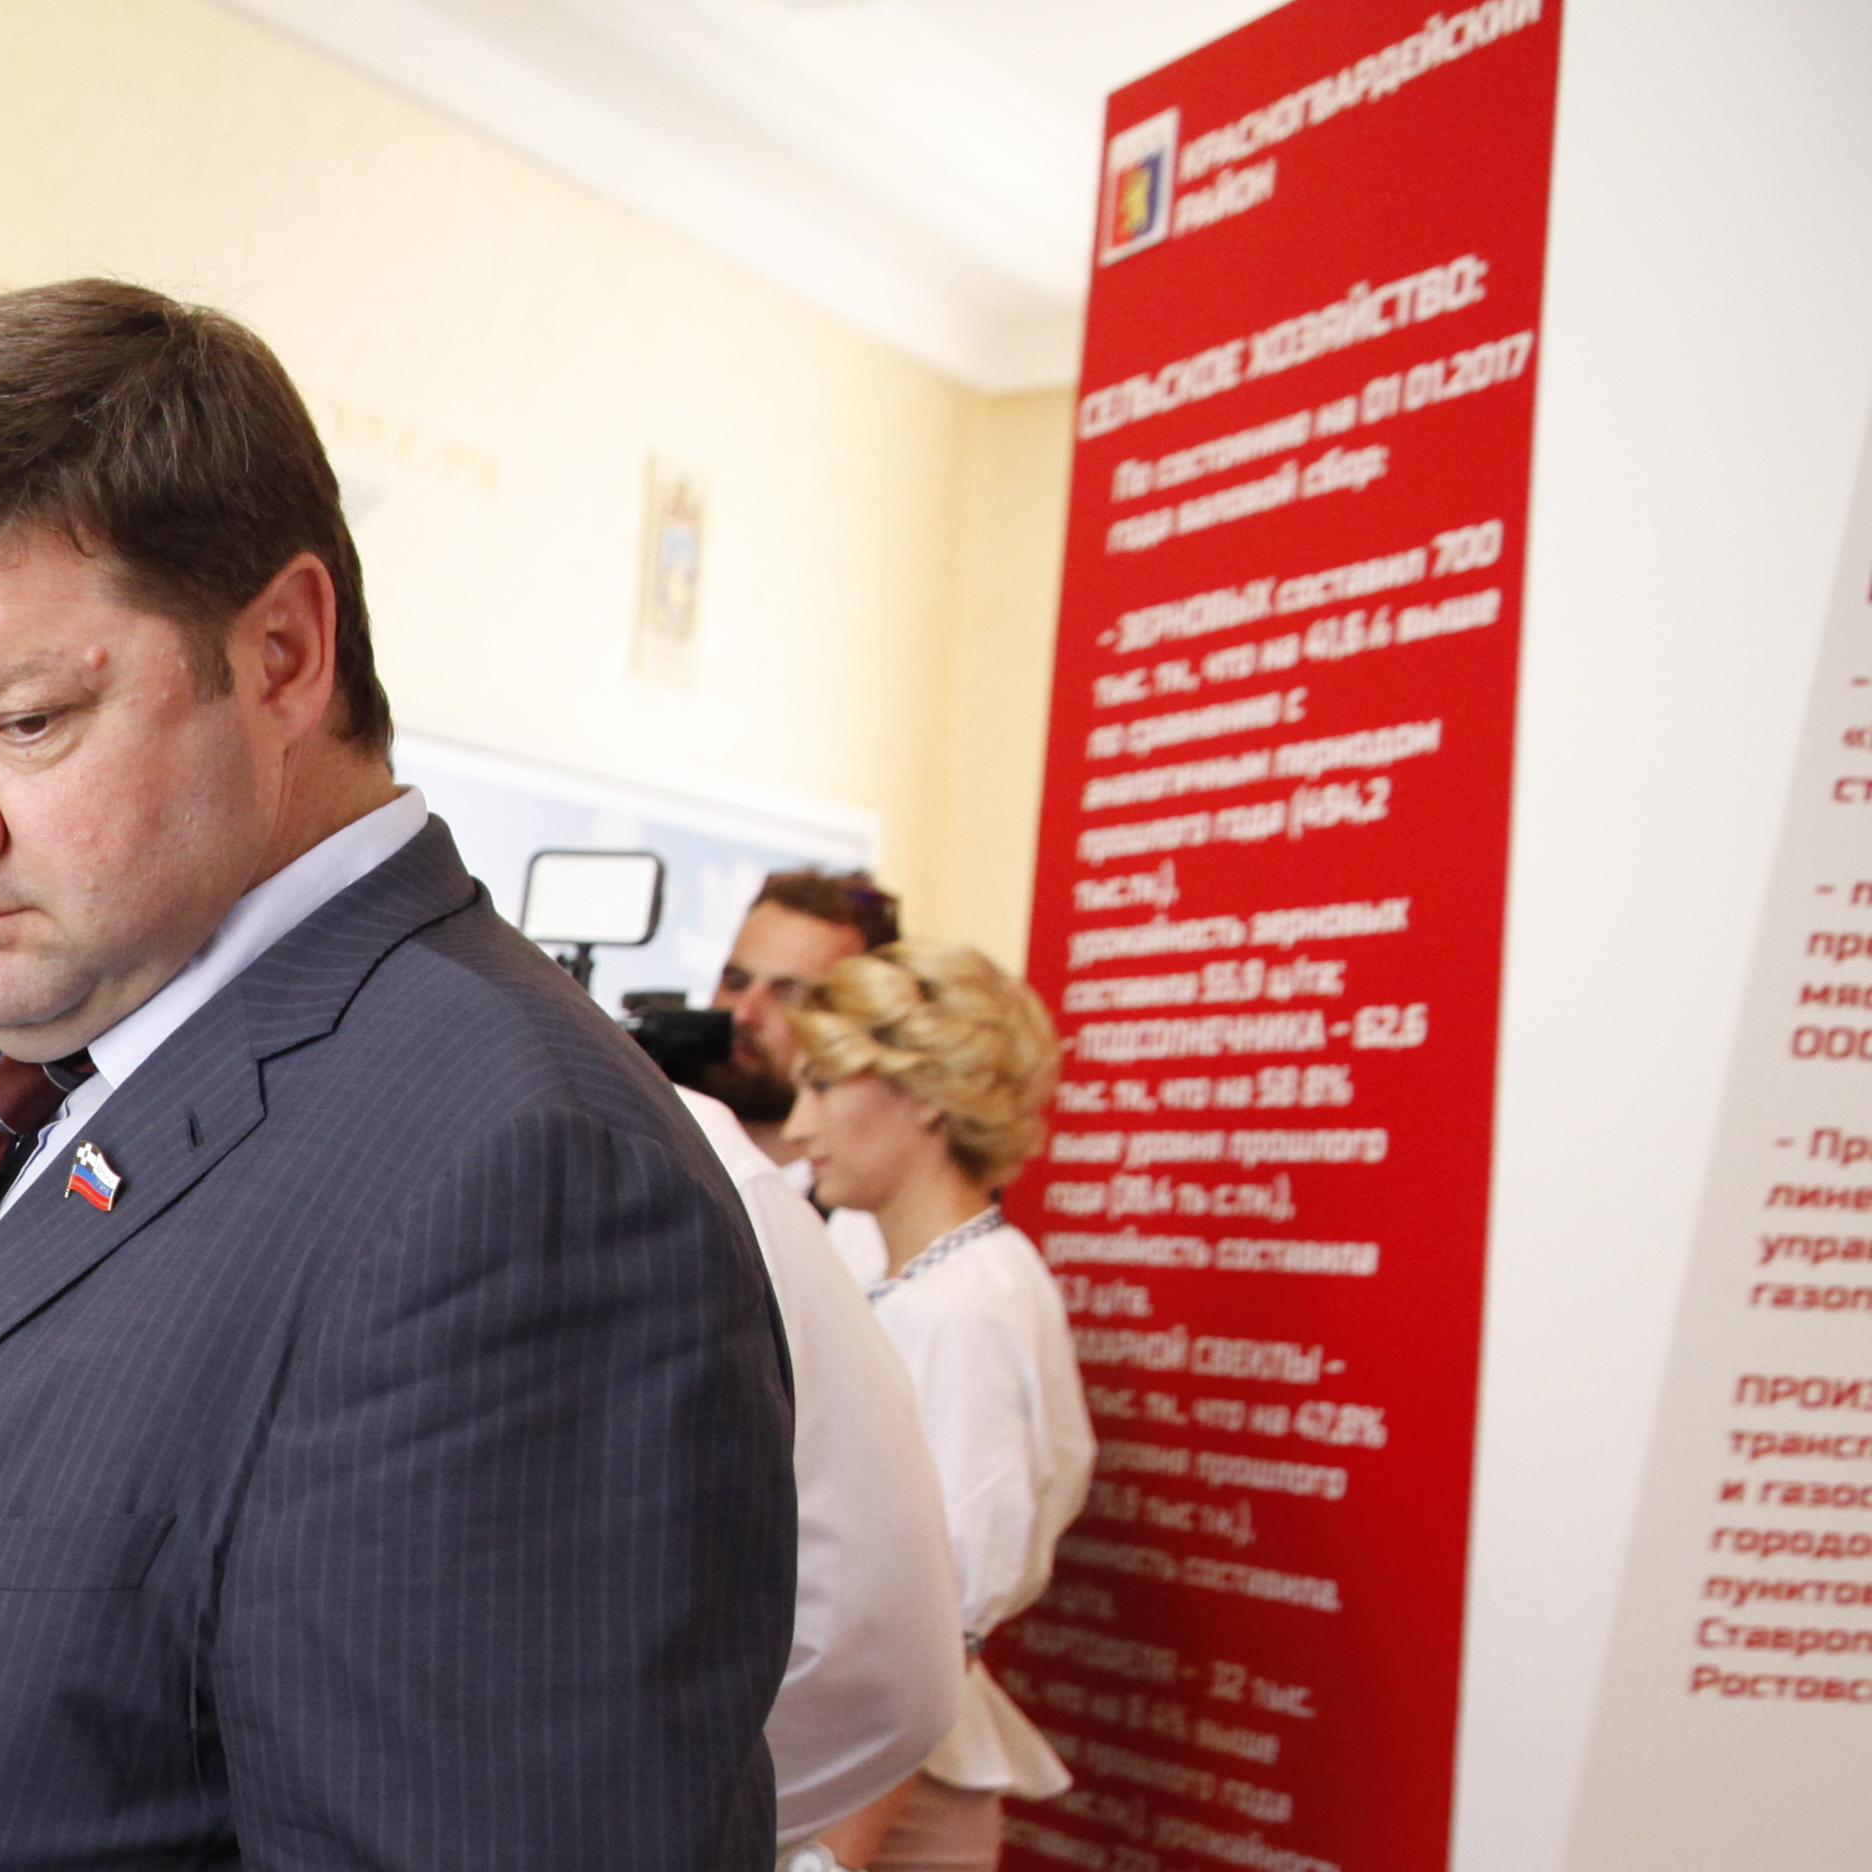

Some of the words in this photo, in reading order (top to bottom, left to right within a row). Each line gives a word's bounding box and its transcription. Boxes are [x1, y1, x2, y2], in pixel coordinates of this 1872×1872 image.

[1173, 157, 1278, 239] РАЙОН
[1075, 337, 1247, 441] СЕЛЬСКОЕ
[1244, 253, 1488, 381] ХОЗЯЙСТВО:
[1312, 394, 1360, 438] на
[1105, 505, 1176, 553] года
[1430, 518, 1504, 577] 700
[1199, 642, 1258, 682] что
[1256, 632, 1302, 672] на
[1392, 587, 1502, 644] выше
[1085, 722, 1128, 760] по
[1280, 685, 1308, 724] с
[1156, 1075, 1213, 1110] что
[1210, 1074, 1255, 1109] на
